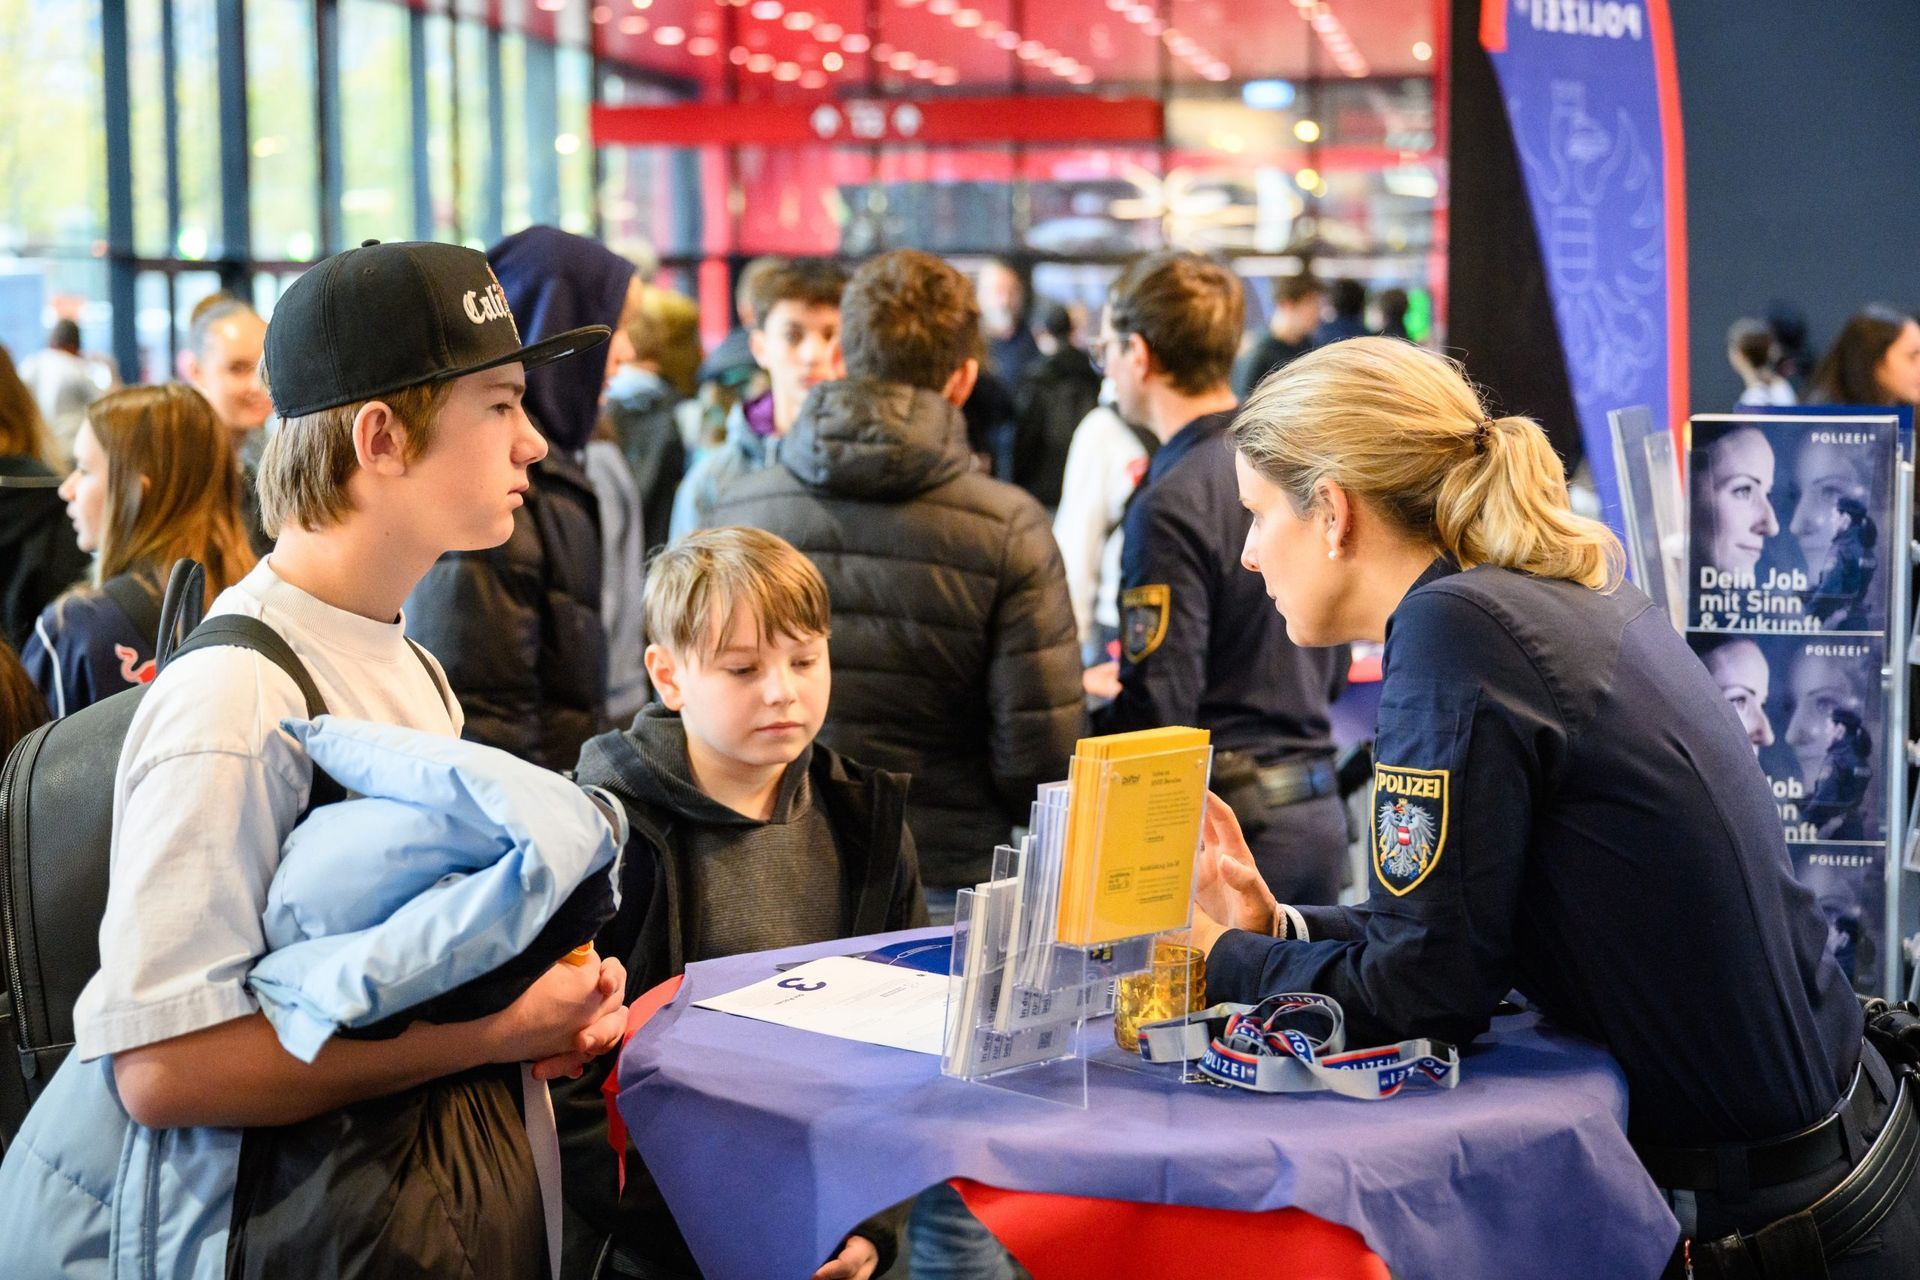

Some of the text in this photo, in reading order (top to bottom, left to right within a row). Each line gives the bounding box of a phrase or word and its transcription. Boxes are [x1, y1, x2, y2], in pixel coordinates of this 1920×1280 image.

[1811, 432, 1867, 444] POLIZEI
[1700, 566, 1807, 591] Dein Job
[1700, 591, 1802, 613] mit Sinn
[1700, 612, 1822, 633] & Zukunft
[1805, 645, 1861, 656] POLIZEI
[1378, 772, 1442, 799] POLIZEI
[1809, 855, 1864, 866] POLIZEI
[776, 977, 827, 992] 3
[1202, 1049, 1246, 1079] POLIZEI
